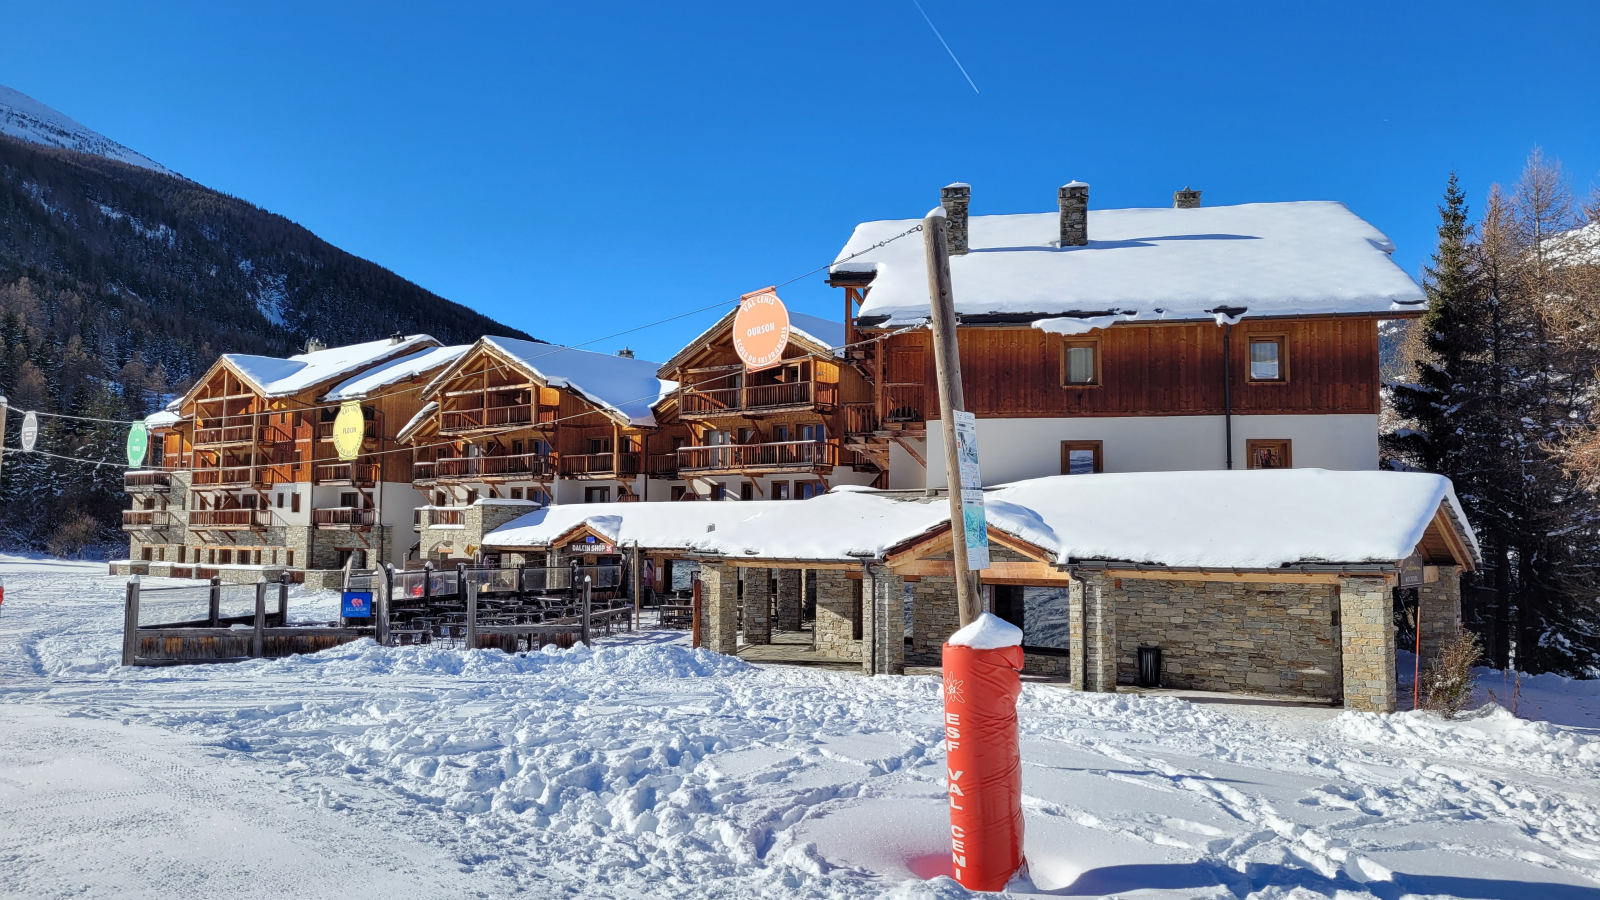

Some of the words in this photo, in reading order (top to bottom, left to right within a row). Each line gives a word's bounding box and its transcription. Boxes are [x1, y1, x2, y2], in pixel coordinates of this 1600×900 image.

[742, 300, 756, 312] VAL
[756, 296, 775, 306] CENIS
[747, 322, 775, 337] OURSON
[736, 338, 749, 358] ECOLE
[748, 356, 757, 364] DU
[757, 356, 768, 364] SKI
[946, 712, 961, 752] ESF
[947, 767, 965, 811] VAL
